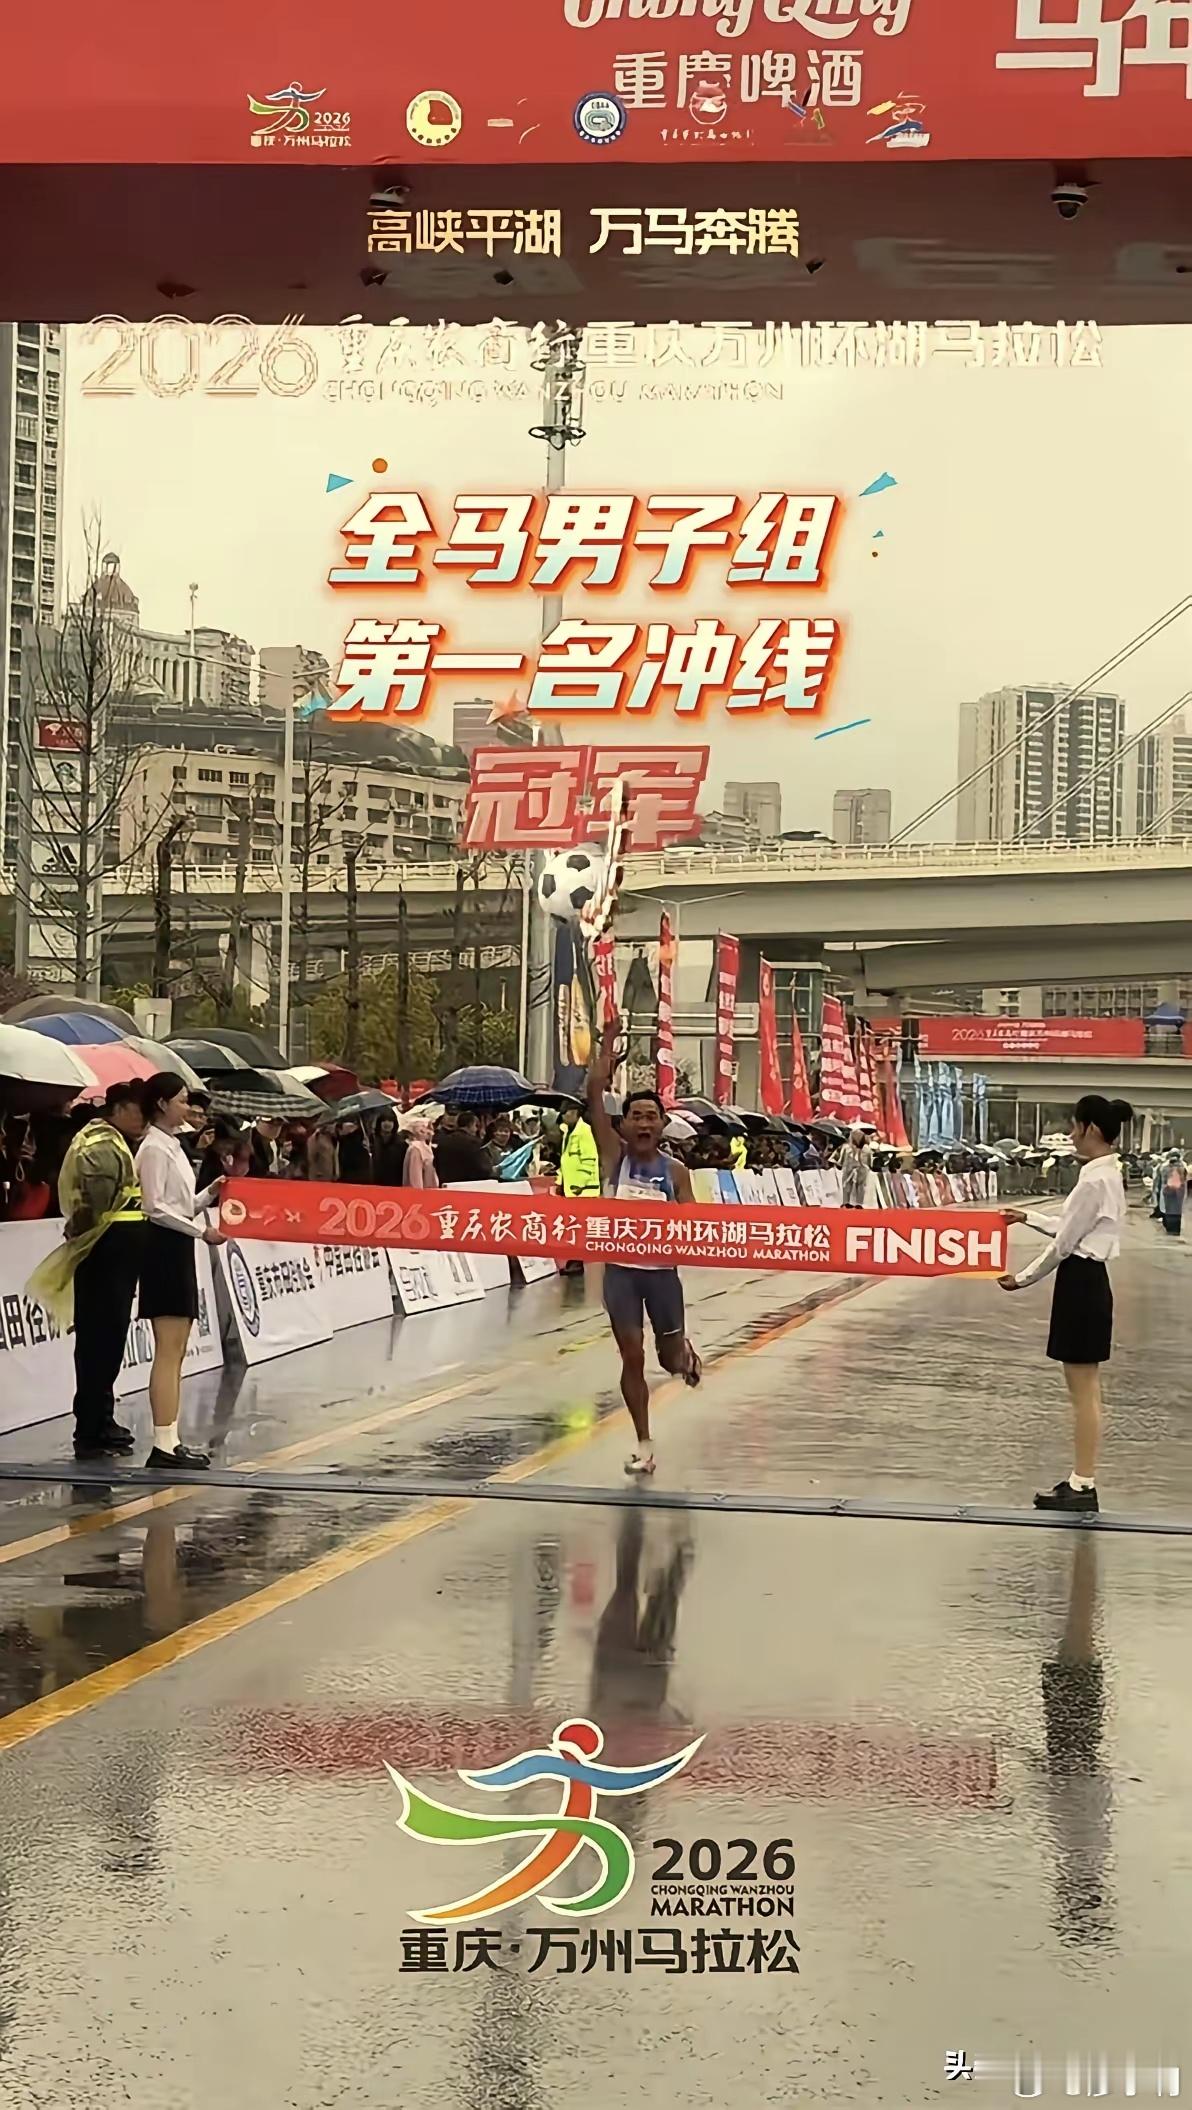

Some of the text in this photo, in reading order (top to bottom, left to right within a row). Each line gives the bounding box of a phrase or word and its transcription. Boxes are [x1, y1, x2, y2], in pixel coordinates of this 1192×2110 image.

[318, 1197, 831, 1250] 2026 重庆农商行 重庆万州环湖马拉松
[585, 1240, 830, 1263] CHONGQING WANZHOU MARATHON
[845, 1226, 1002, 1268] FINISH
